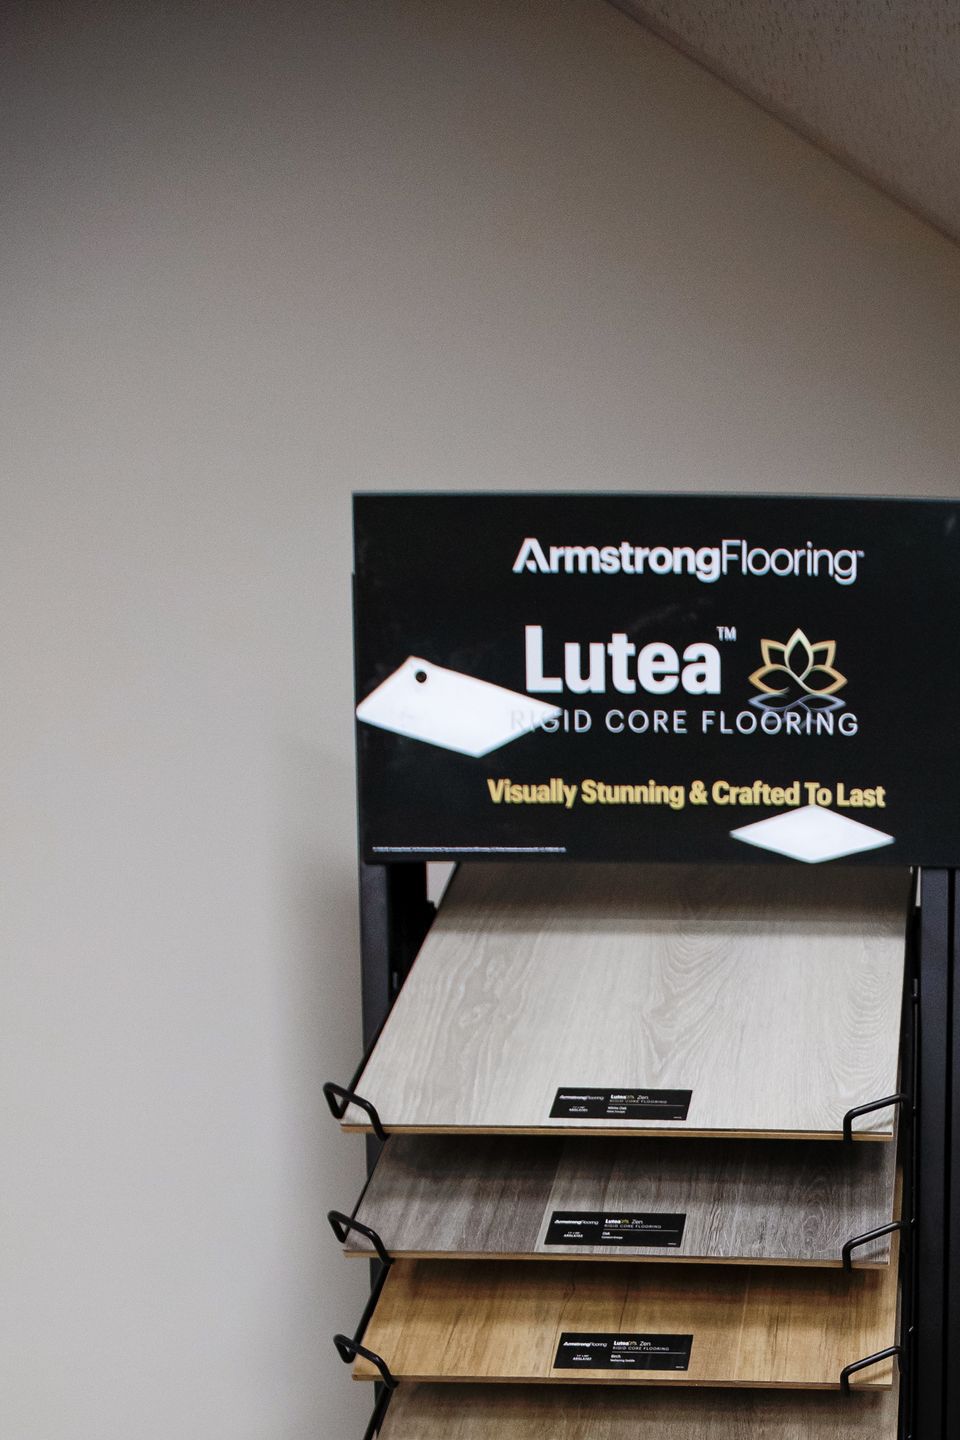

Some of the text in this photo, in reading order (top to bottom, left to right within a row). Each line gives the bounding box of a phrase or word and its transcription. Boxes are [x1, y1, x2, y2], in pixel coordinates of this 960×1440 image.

[511, 708, 859, 736] RIGID CORE FLOORING
[486, 777, 886, 810] Visually Stunning & Crafted To Last
